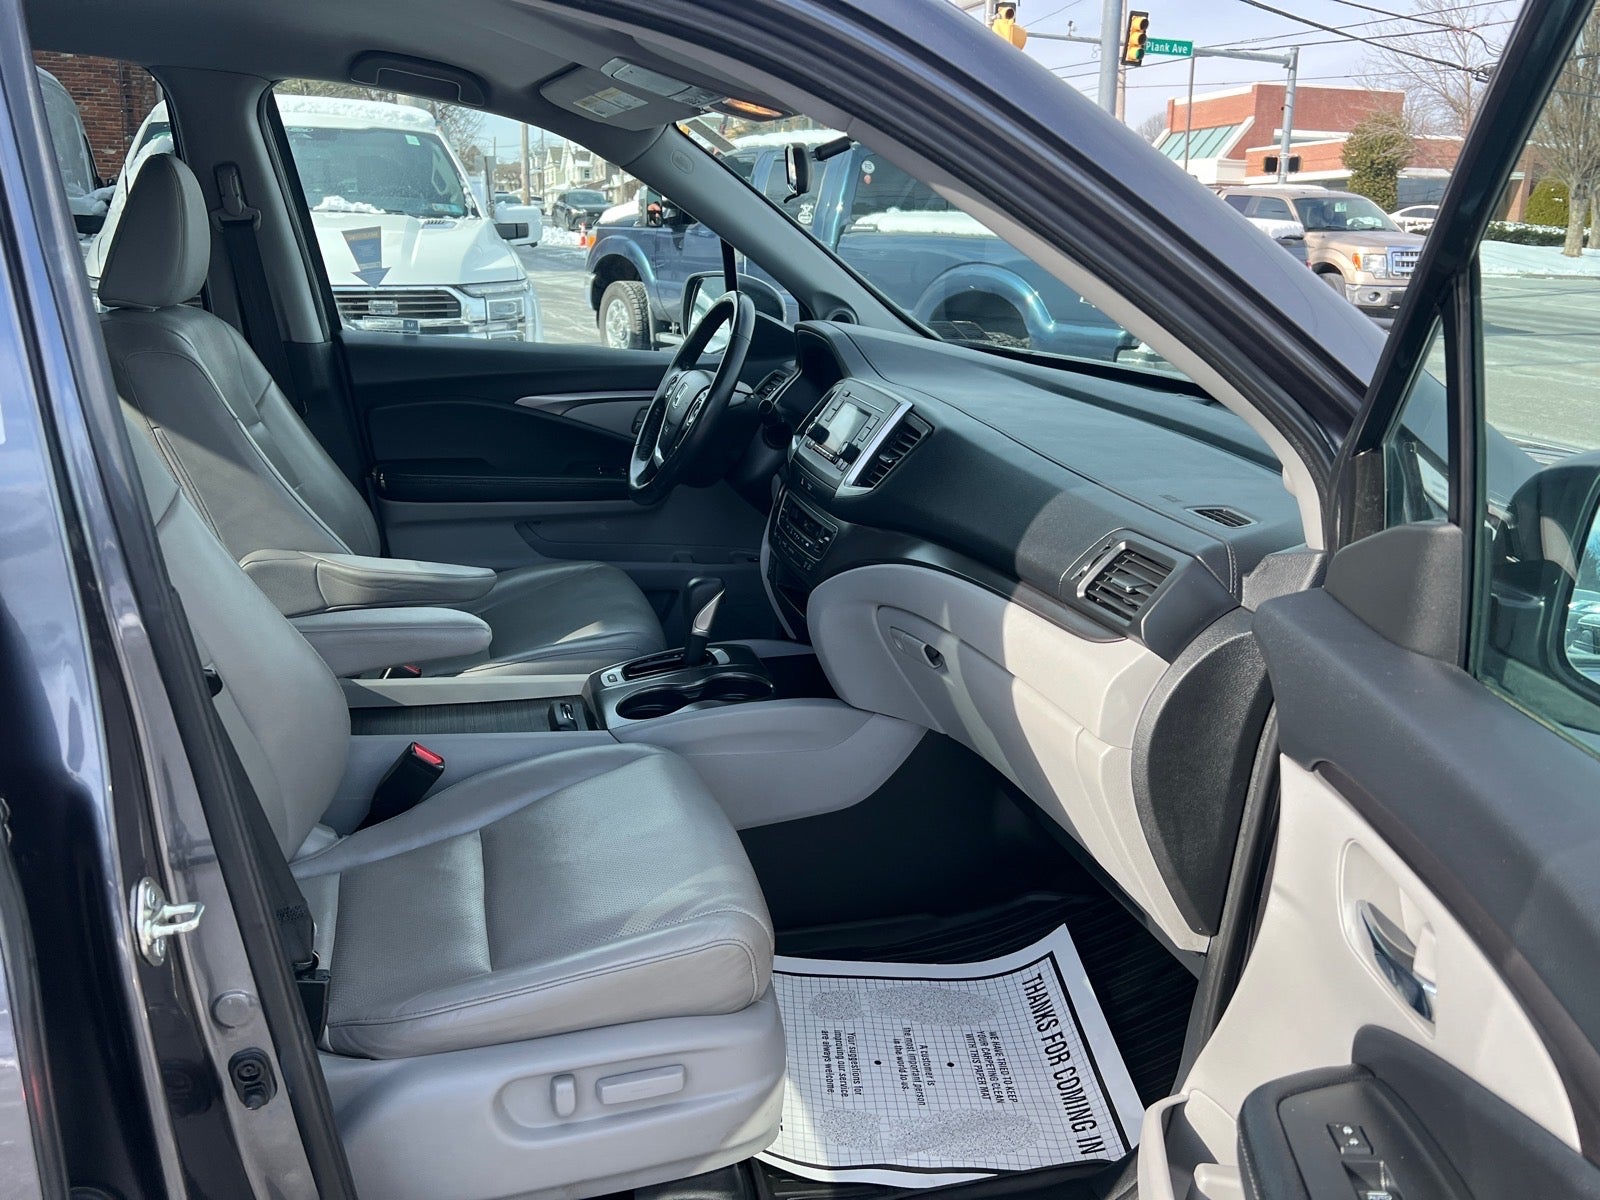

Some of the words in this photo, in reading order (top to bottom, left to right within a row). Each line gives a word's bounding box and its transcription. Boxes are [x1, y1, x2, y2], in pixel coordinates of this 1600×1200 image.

[1146, 41, 1170, 52] Plank
[1172, 43, 1188, 54] Ave
[1022, 973, 1059, 1032] THANKS
[833, 1030, 844, 1059] improving
[847, 1032, 856, 1045] Your
[965, 1034, 976, 1048] WITH
[977, 1031, 988, 1046] YOUR
[990, 1032, 999, 1040] WE
[822, 1041, 832, 1062] always
[894, 1046, 903, 1055] the
[906, 1038, 915, 1052] most
[992, 1042, 1004, 1056] HAVE
[1041, 1031, 1070, 1066] FOR
[896, 1057, 907, 1072] world
[921, 1051, 933, 1078] customer
[970, 1050, 980, 1063] THIS
[982, 1048, 998, 1081] CARPETING
[838, 1061, 846, 1071] our
[848, 1047, 861, 1084] suggestions
[908, 1054, 922, 1082] important
[997, 1058, 1009, 1075] TRIED
[974, 1065, 986, 1084] PAPER
[839, 1073, 849, 1097] service
[854, 1086, 863, 1095] for
[980, 1087, 991, 1100] MAT
[992, 1083, 1005, 1103] CLEAN
[913, 1084, 926, 1105] person
[1006, 1087, 1018, 1102] KEEP
[1054, 1066, 1097, 1132] COMING
[1077, 1136, 1106, 1154] IN
